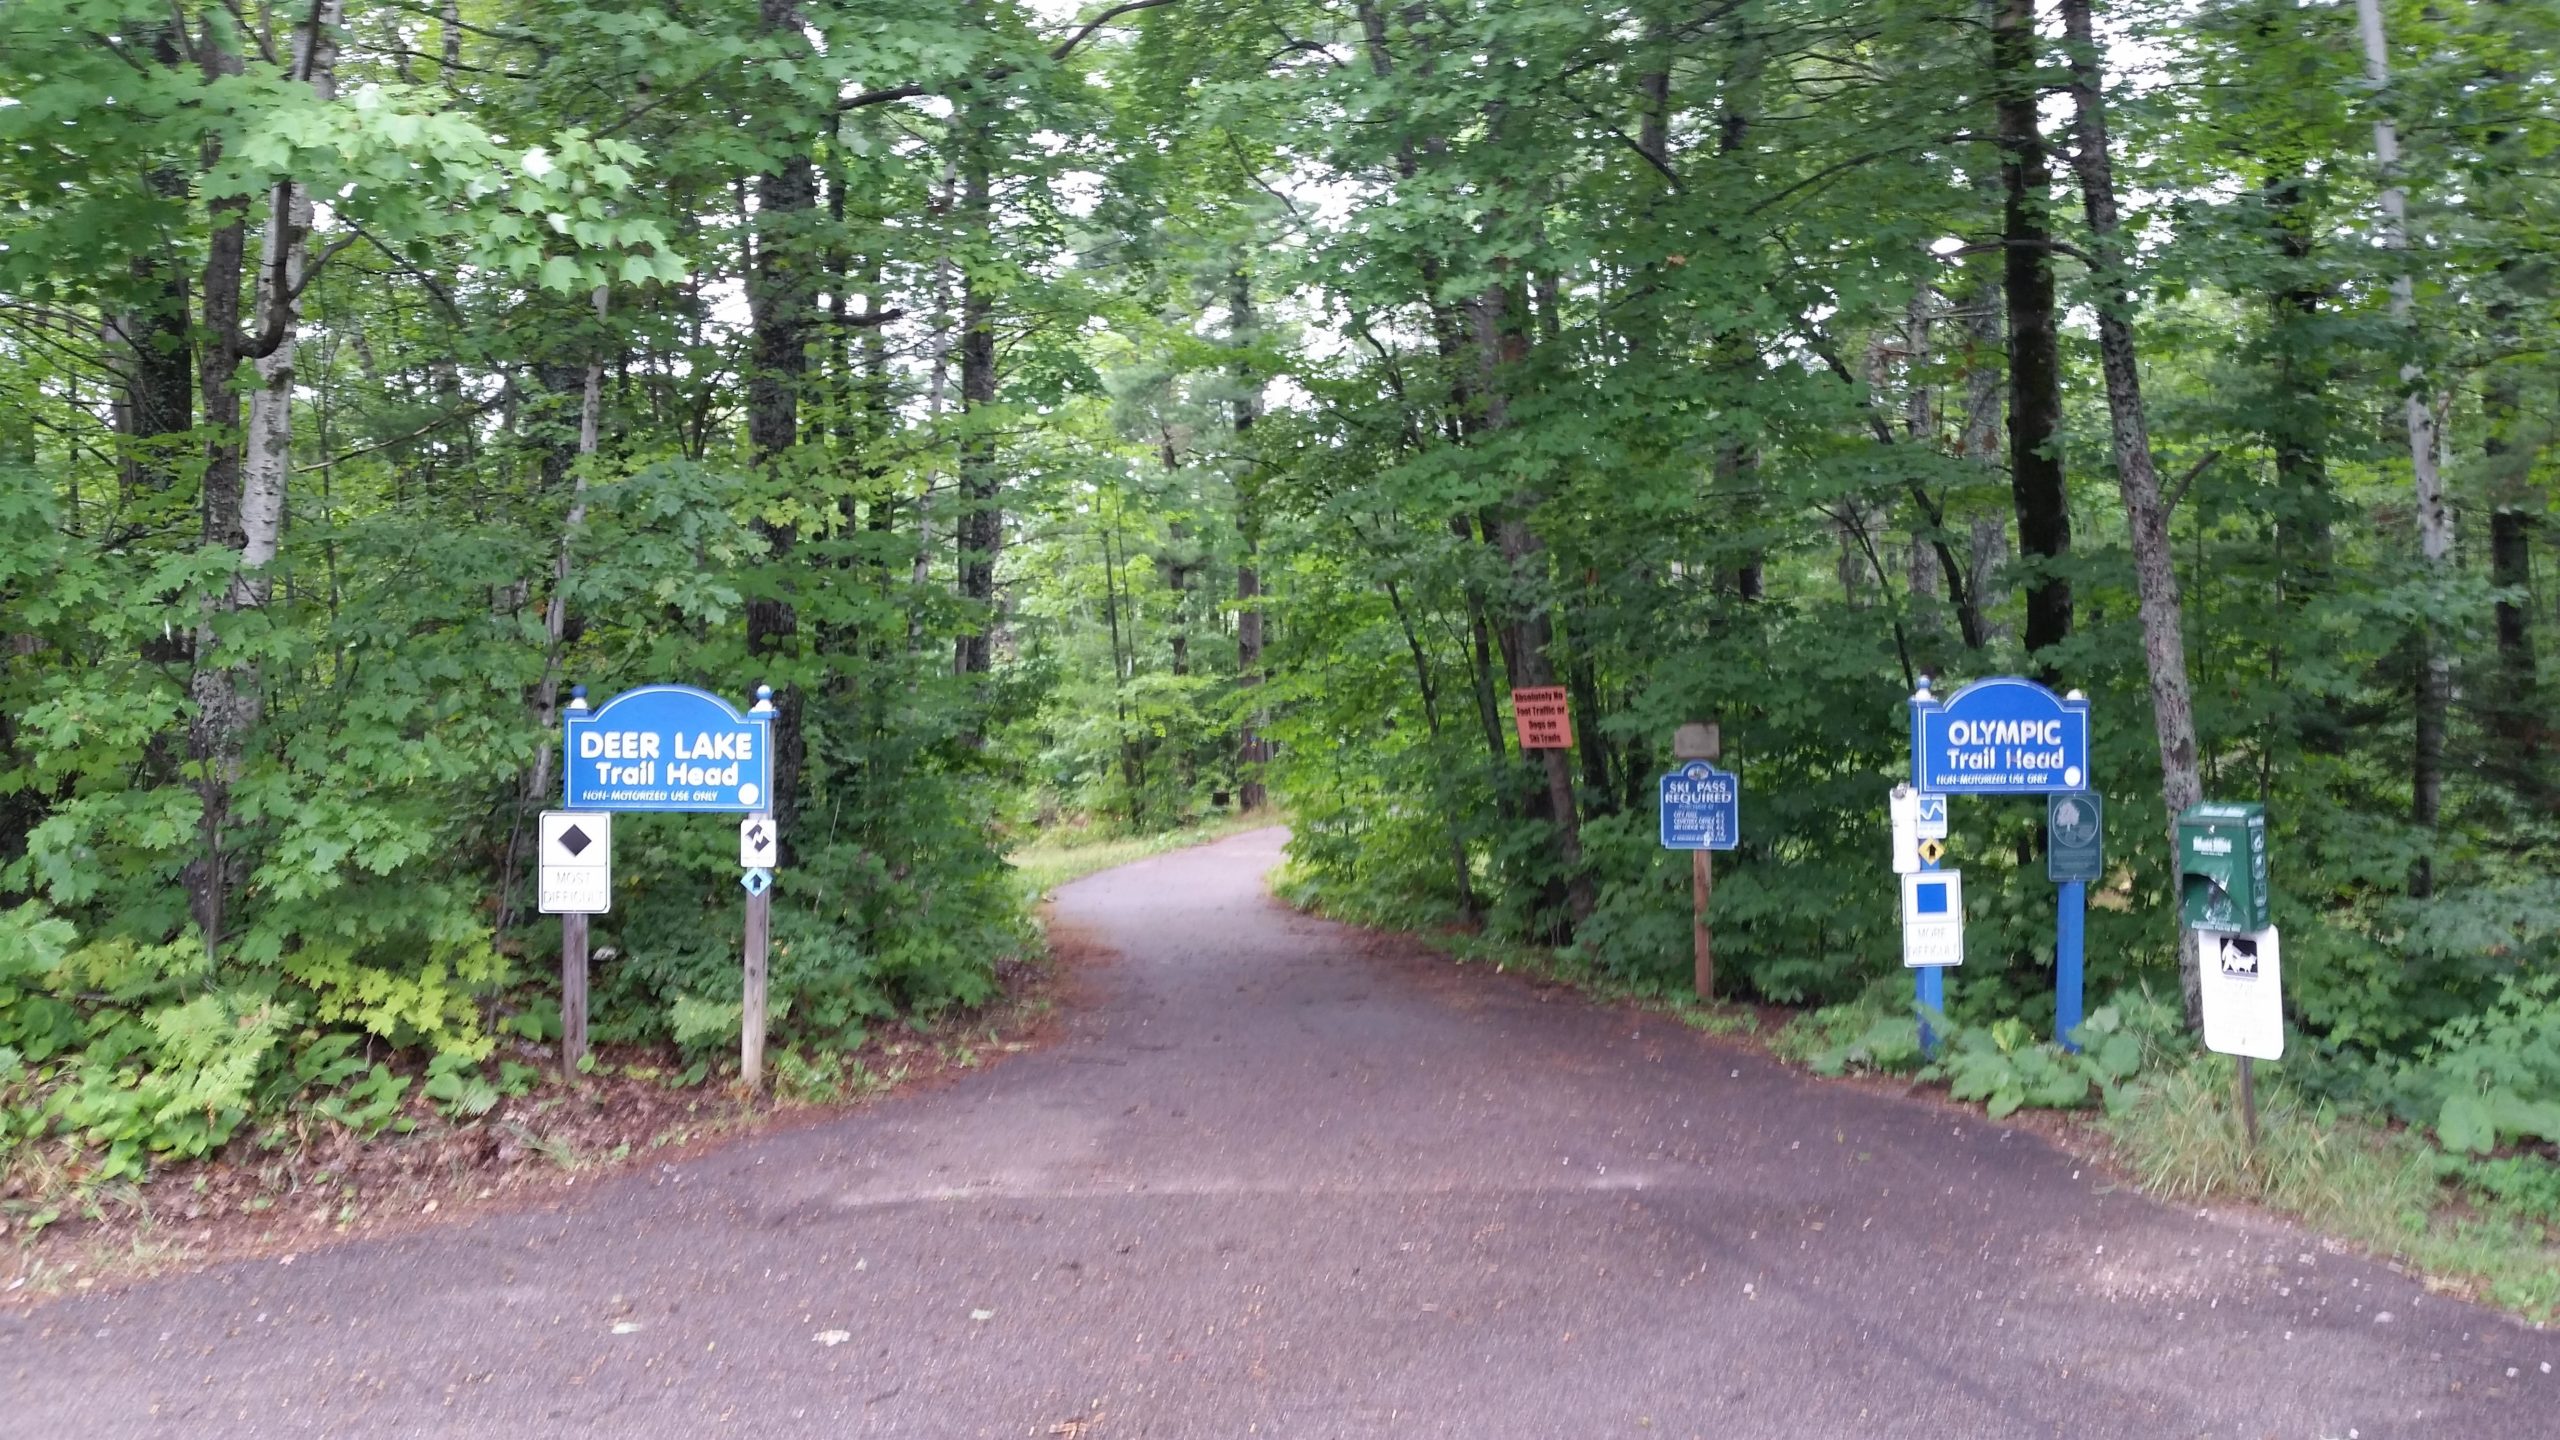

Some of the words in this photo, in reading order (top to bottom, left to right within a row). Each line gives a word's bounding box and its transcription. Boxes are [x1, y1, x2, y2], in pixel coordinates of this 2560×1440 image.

[1514, 692, 1552, 703] Absolutely
[1553, 691, 1563, 700] No
[1516, 707, 1532, 717] Foot
[1533, 705, 1556, 716] Traffic
[1528, 720, 1546, 731] Dogs
[1547, 720, 1557, 730] on
[1948, 719, 2062, 746] OLYMPIC
[1529, 734, 1540, 744] Ski
[1540, 734, 1561, 744] Trails
[580, 731, 660, 759] DEER
[674, 731, 753, 761] LAKE
[1946, 746, 1996, 770] Trail
[2005, 745, 2065, 770] Head
[595, 761, 655, 786] Trail
[666, 761, 739, 787] Head
[1936, 773, 2007, 785] NON-MOTORIZED
[2008, 773, 2024, 785] USE
[2027, 773, 2049, 785] ONLY
[1669, 780, 1690, 793] SKI
[1696, 779, 1727, 793] PASS
[670, 790, 690, 802] USE
[693, 790, 718, 802] ONLY
[1665, 792, 1732, 804] REQUIRED
